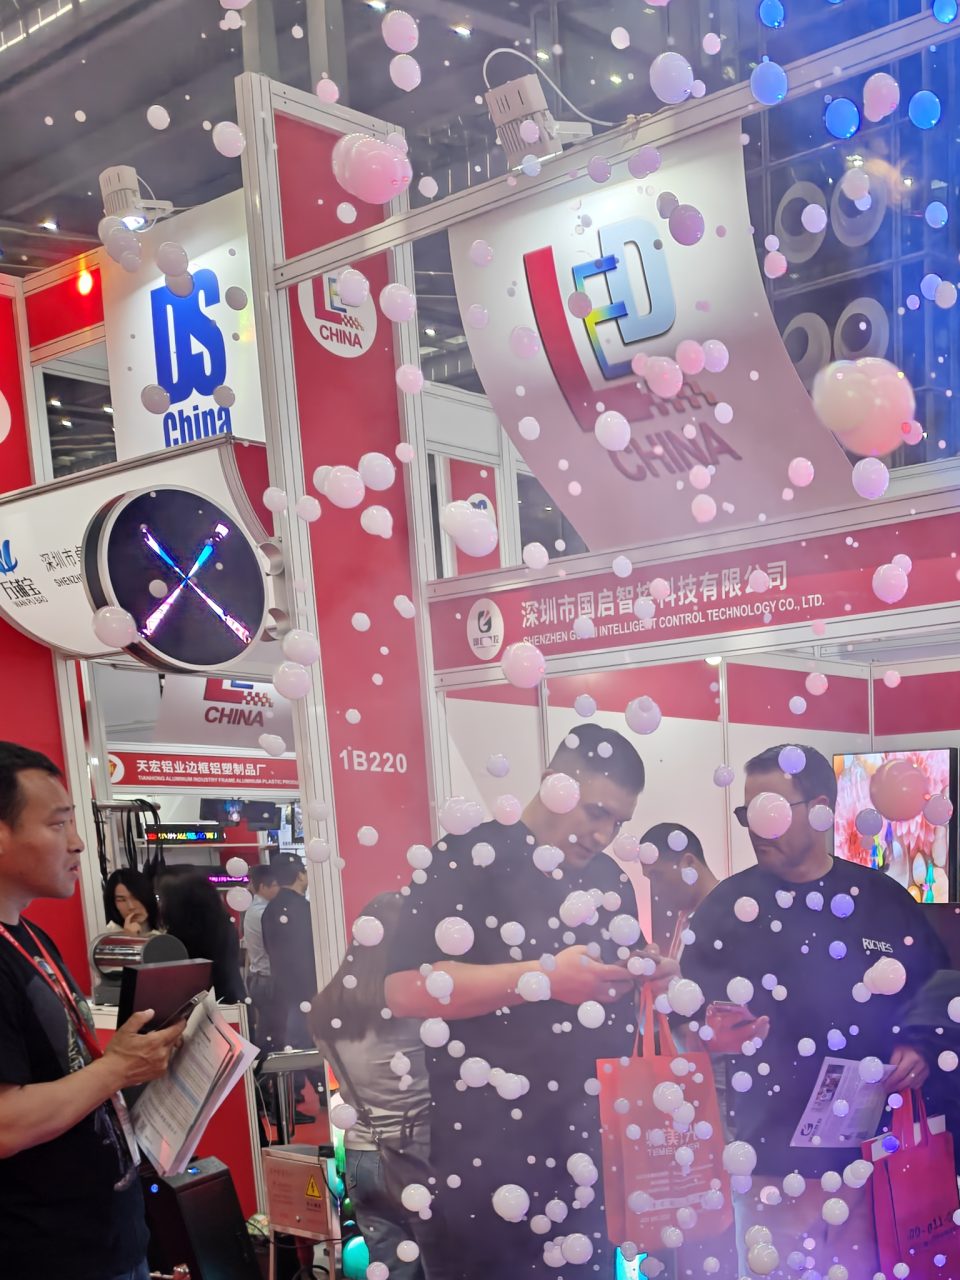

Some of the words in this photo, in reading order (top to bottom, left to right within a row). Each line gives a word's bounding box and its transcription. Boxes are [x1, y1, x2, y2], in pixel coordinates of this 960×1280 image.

[150, 268, 227, 406] DS
[319, 324, 364, 350] CHINA
[606, 421, 744, 482] CHINA
[53, 573, 82, 588] SHENZH
[523, 631, 568, 646] SHENZHEN
[659, 610, 705, 629] CONTROL
[707, 600, 776, 621] TECHNOLOGY
[779, 597, 800, 612] CO.,
[801, 593, 825, 608] LTD.
[204, 705, 265, 728] CHINA
[136, 759, 267, 776] 天宏铝业边框铝塑制品厂
[339, 749, 408, 774] 1B220
[862, 937, 893, 953] RICHES
